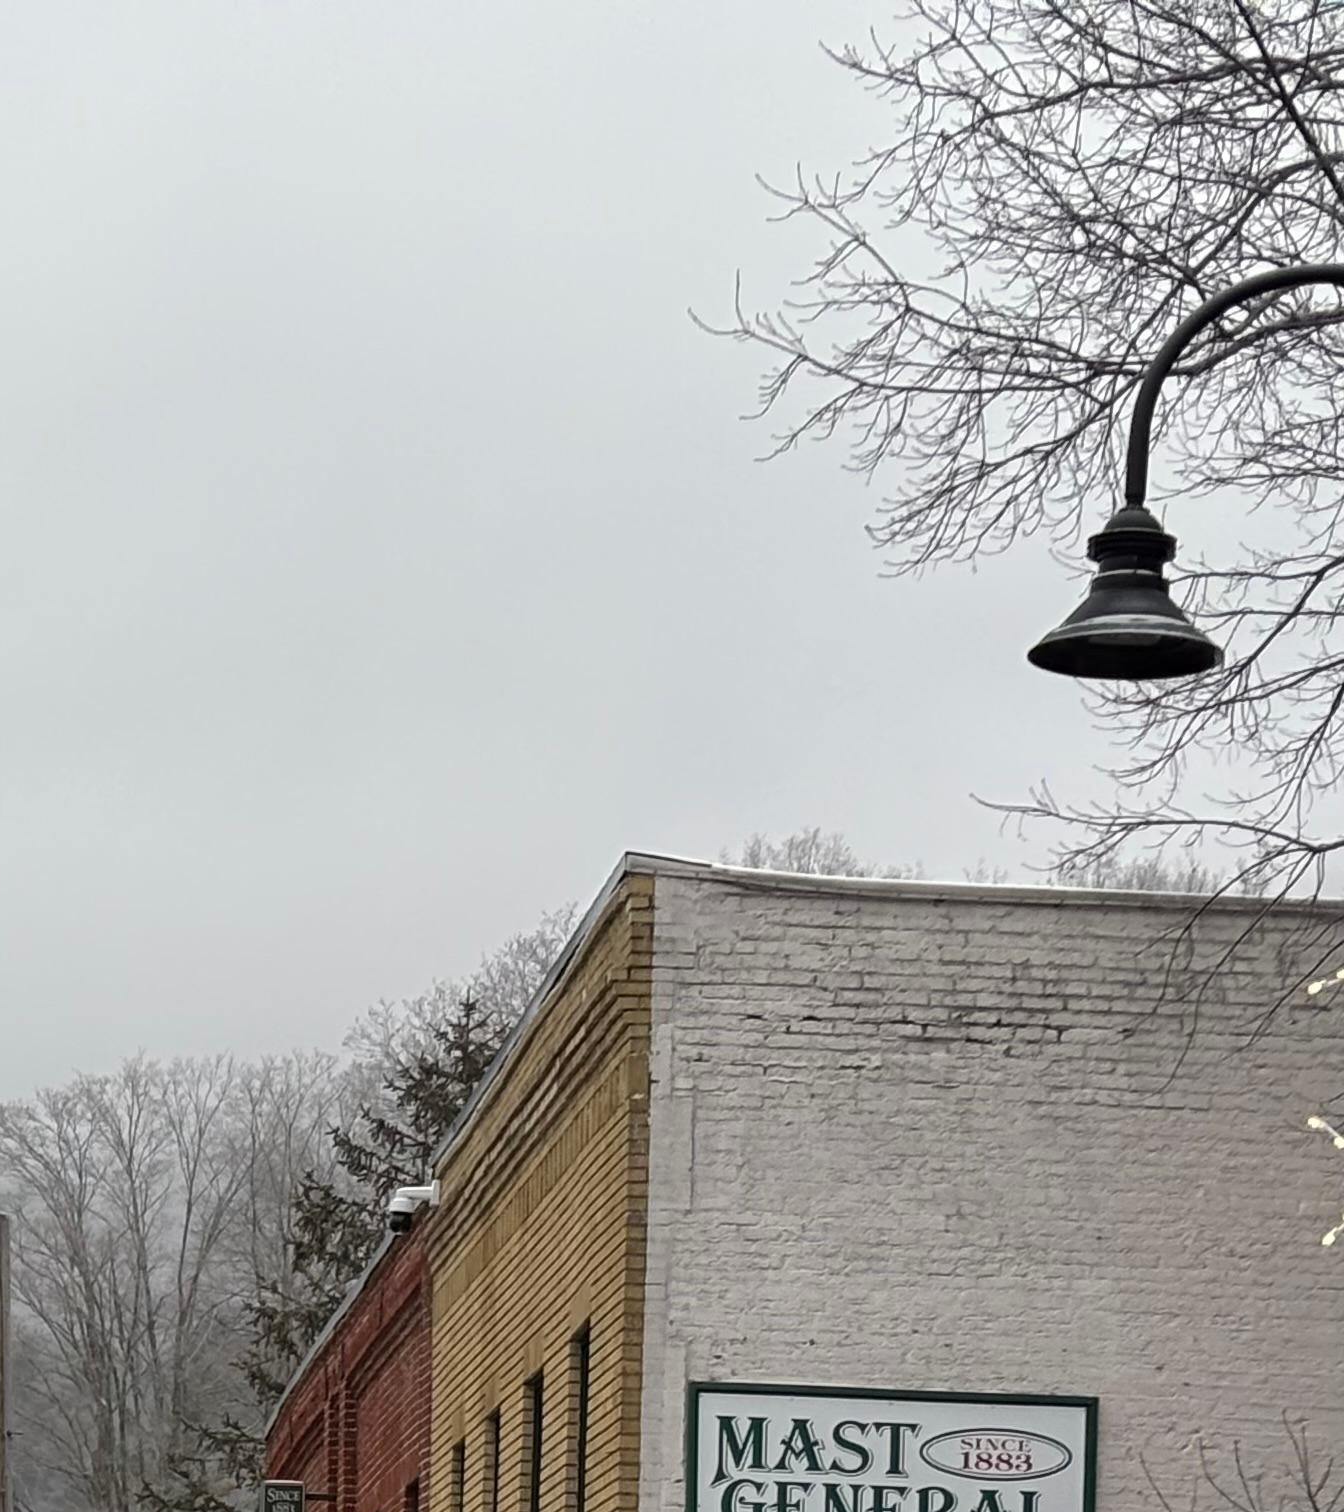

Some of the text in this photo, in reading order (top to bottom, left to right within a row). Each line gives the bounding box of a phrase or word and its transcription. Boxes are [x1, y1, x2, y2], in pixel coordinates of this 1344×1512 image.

[710, 1415, 921, 1487] MAST
[960, 1438, 1032, 1454] SINCE
[960, 1451, 1033, 1472] 1883
[266, 1488, 301, 1503] SINCE
